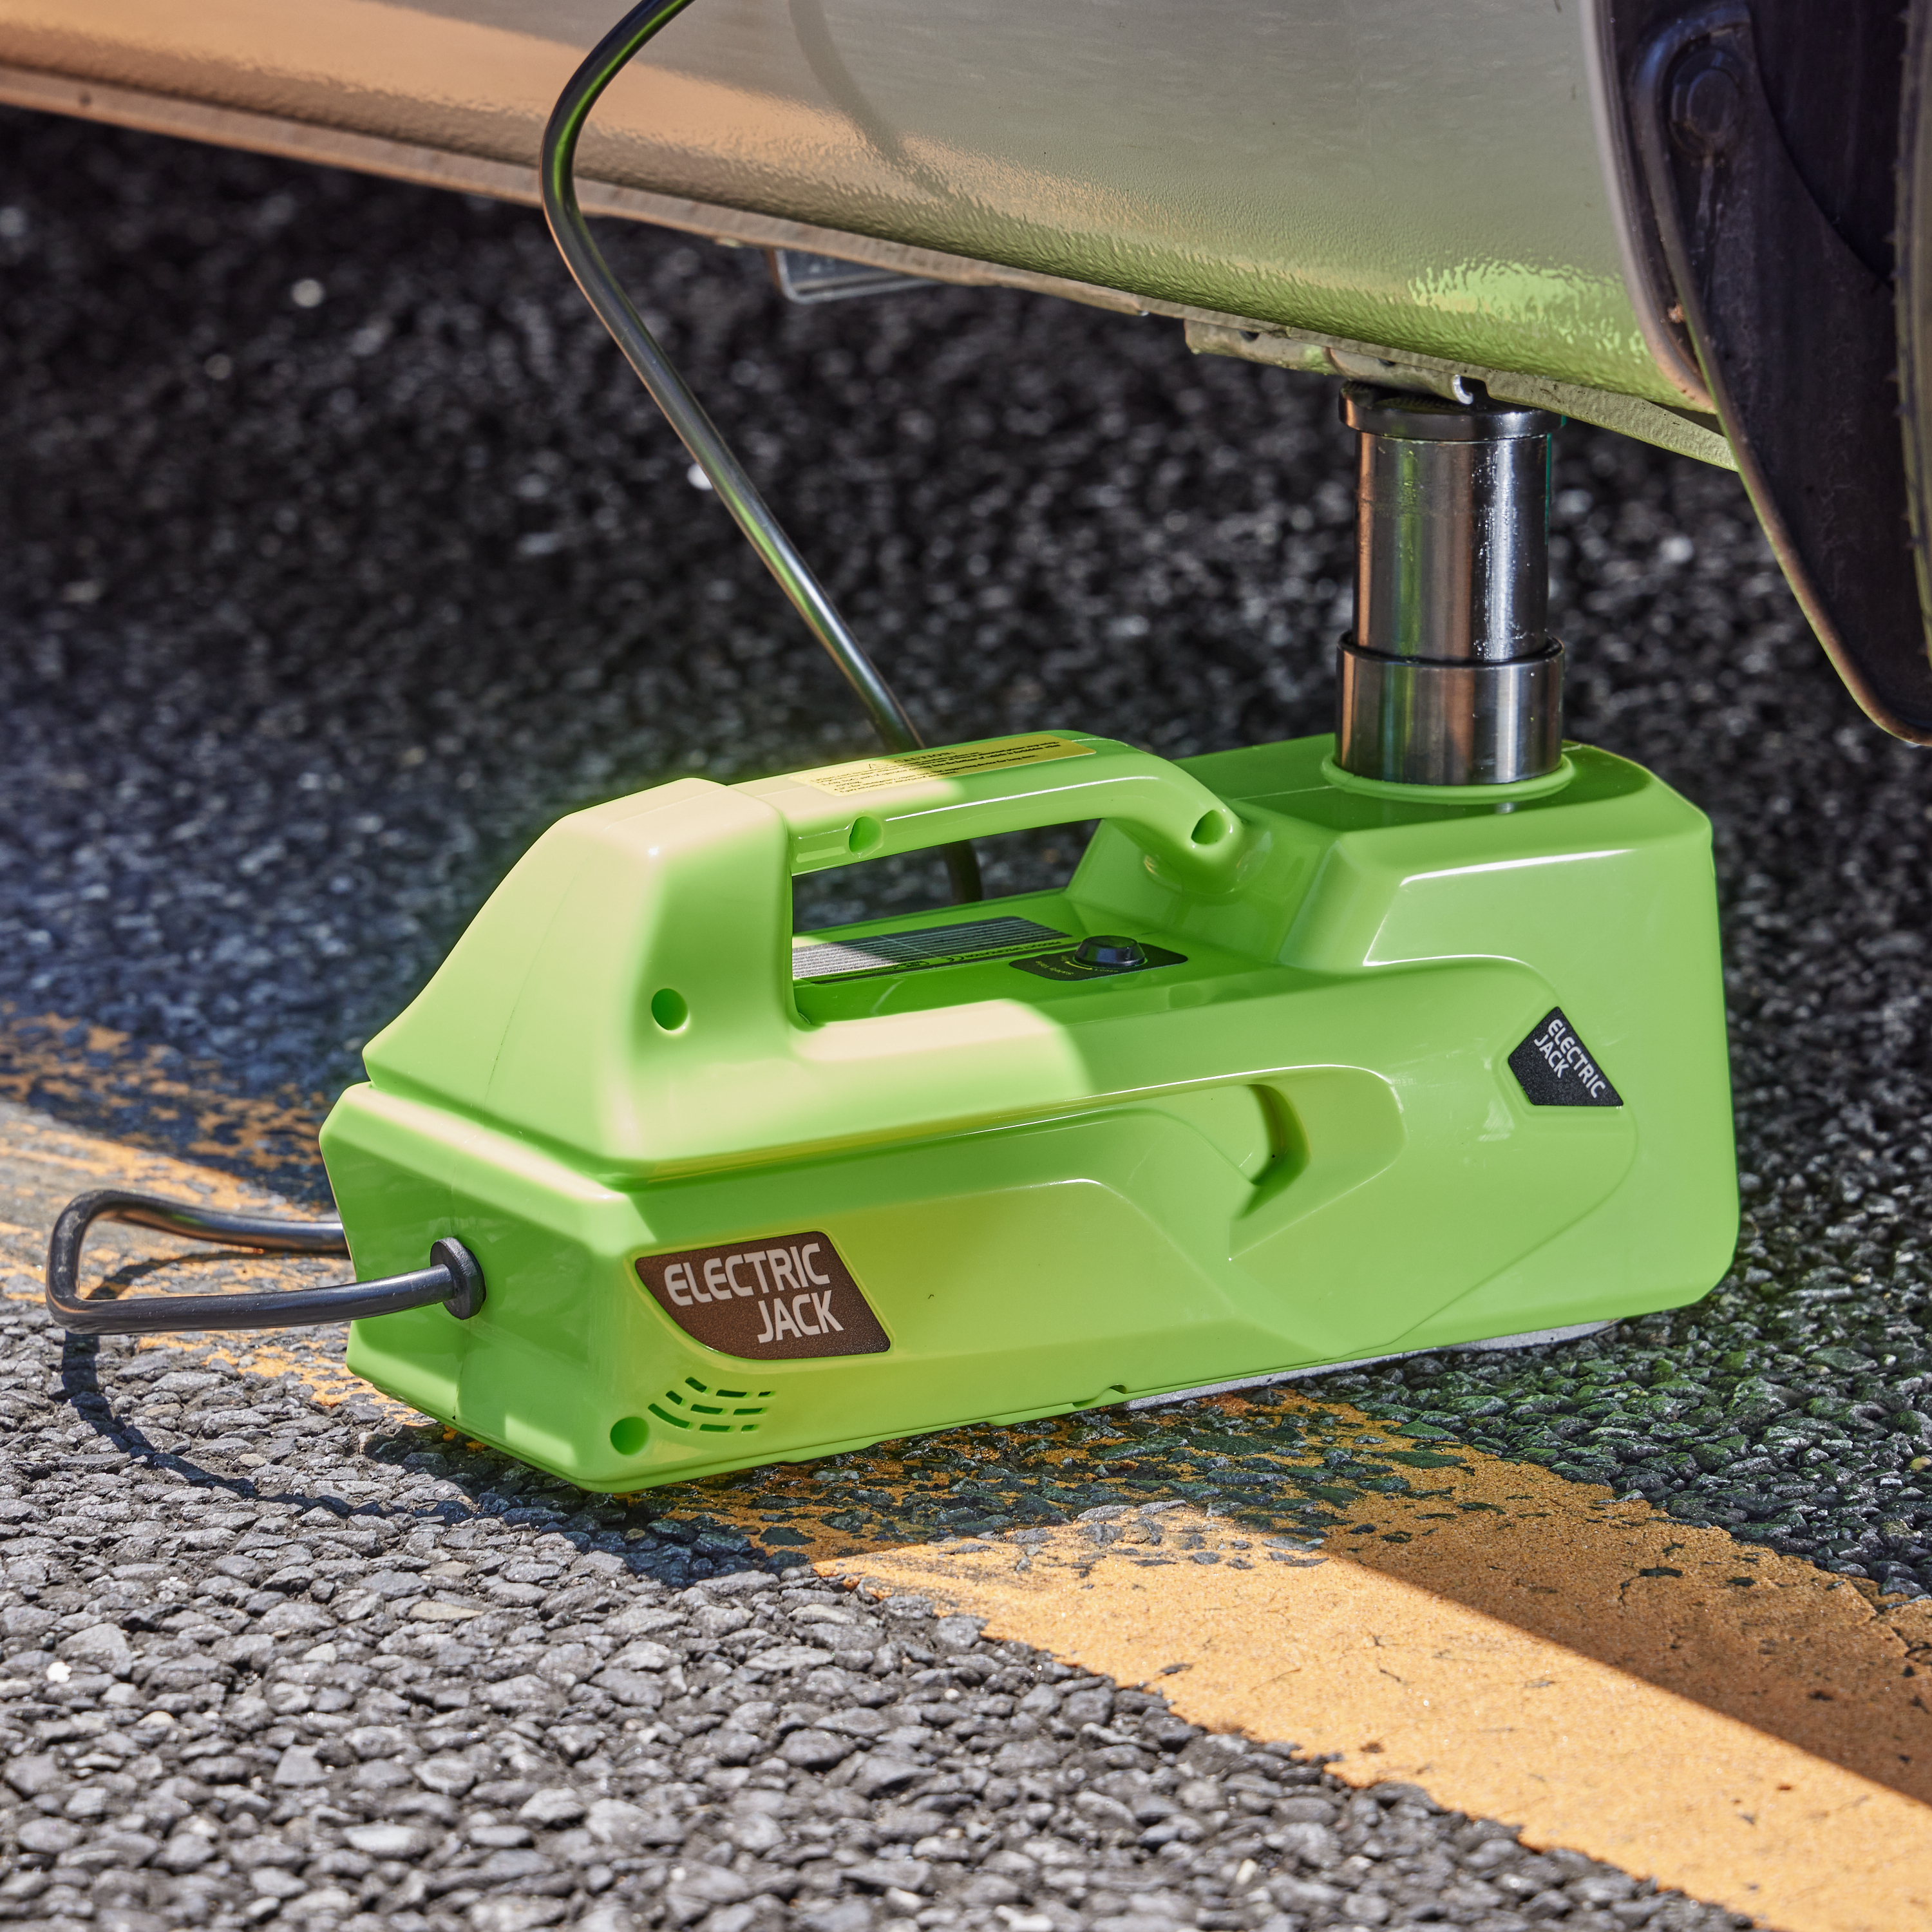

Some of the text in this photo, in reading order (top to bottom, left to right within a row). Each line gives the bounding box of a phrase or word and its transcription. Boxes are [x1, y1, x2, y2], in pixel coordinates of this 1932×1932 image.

[1533, 1034, 1569, 1079] JACK
[1548, 1019, 1606, 1099] ELECTRIC
[664, 1242, 831, 1306] ELECTRIC
[757, 1290, 844, 1343] JACK
